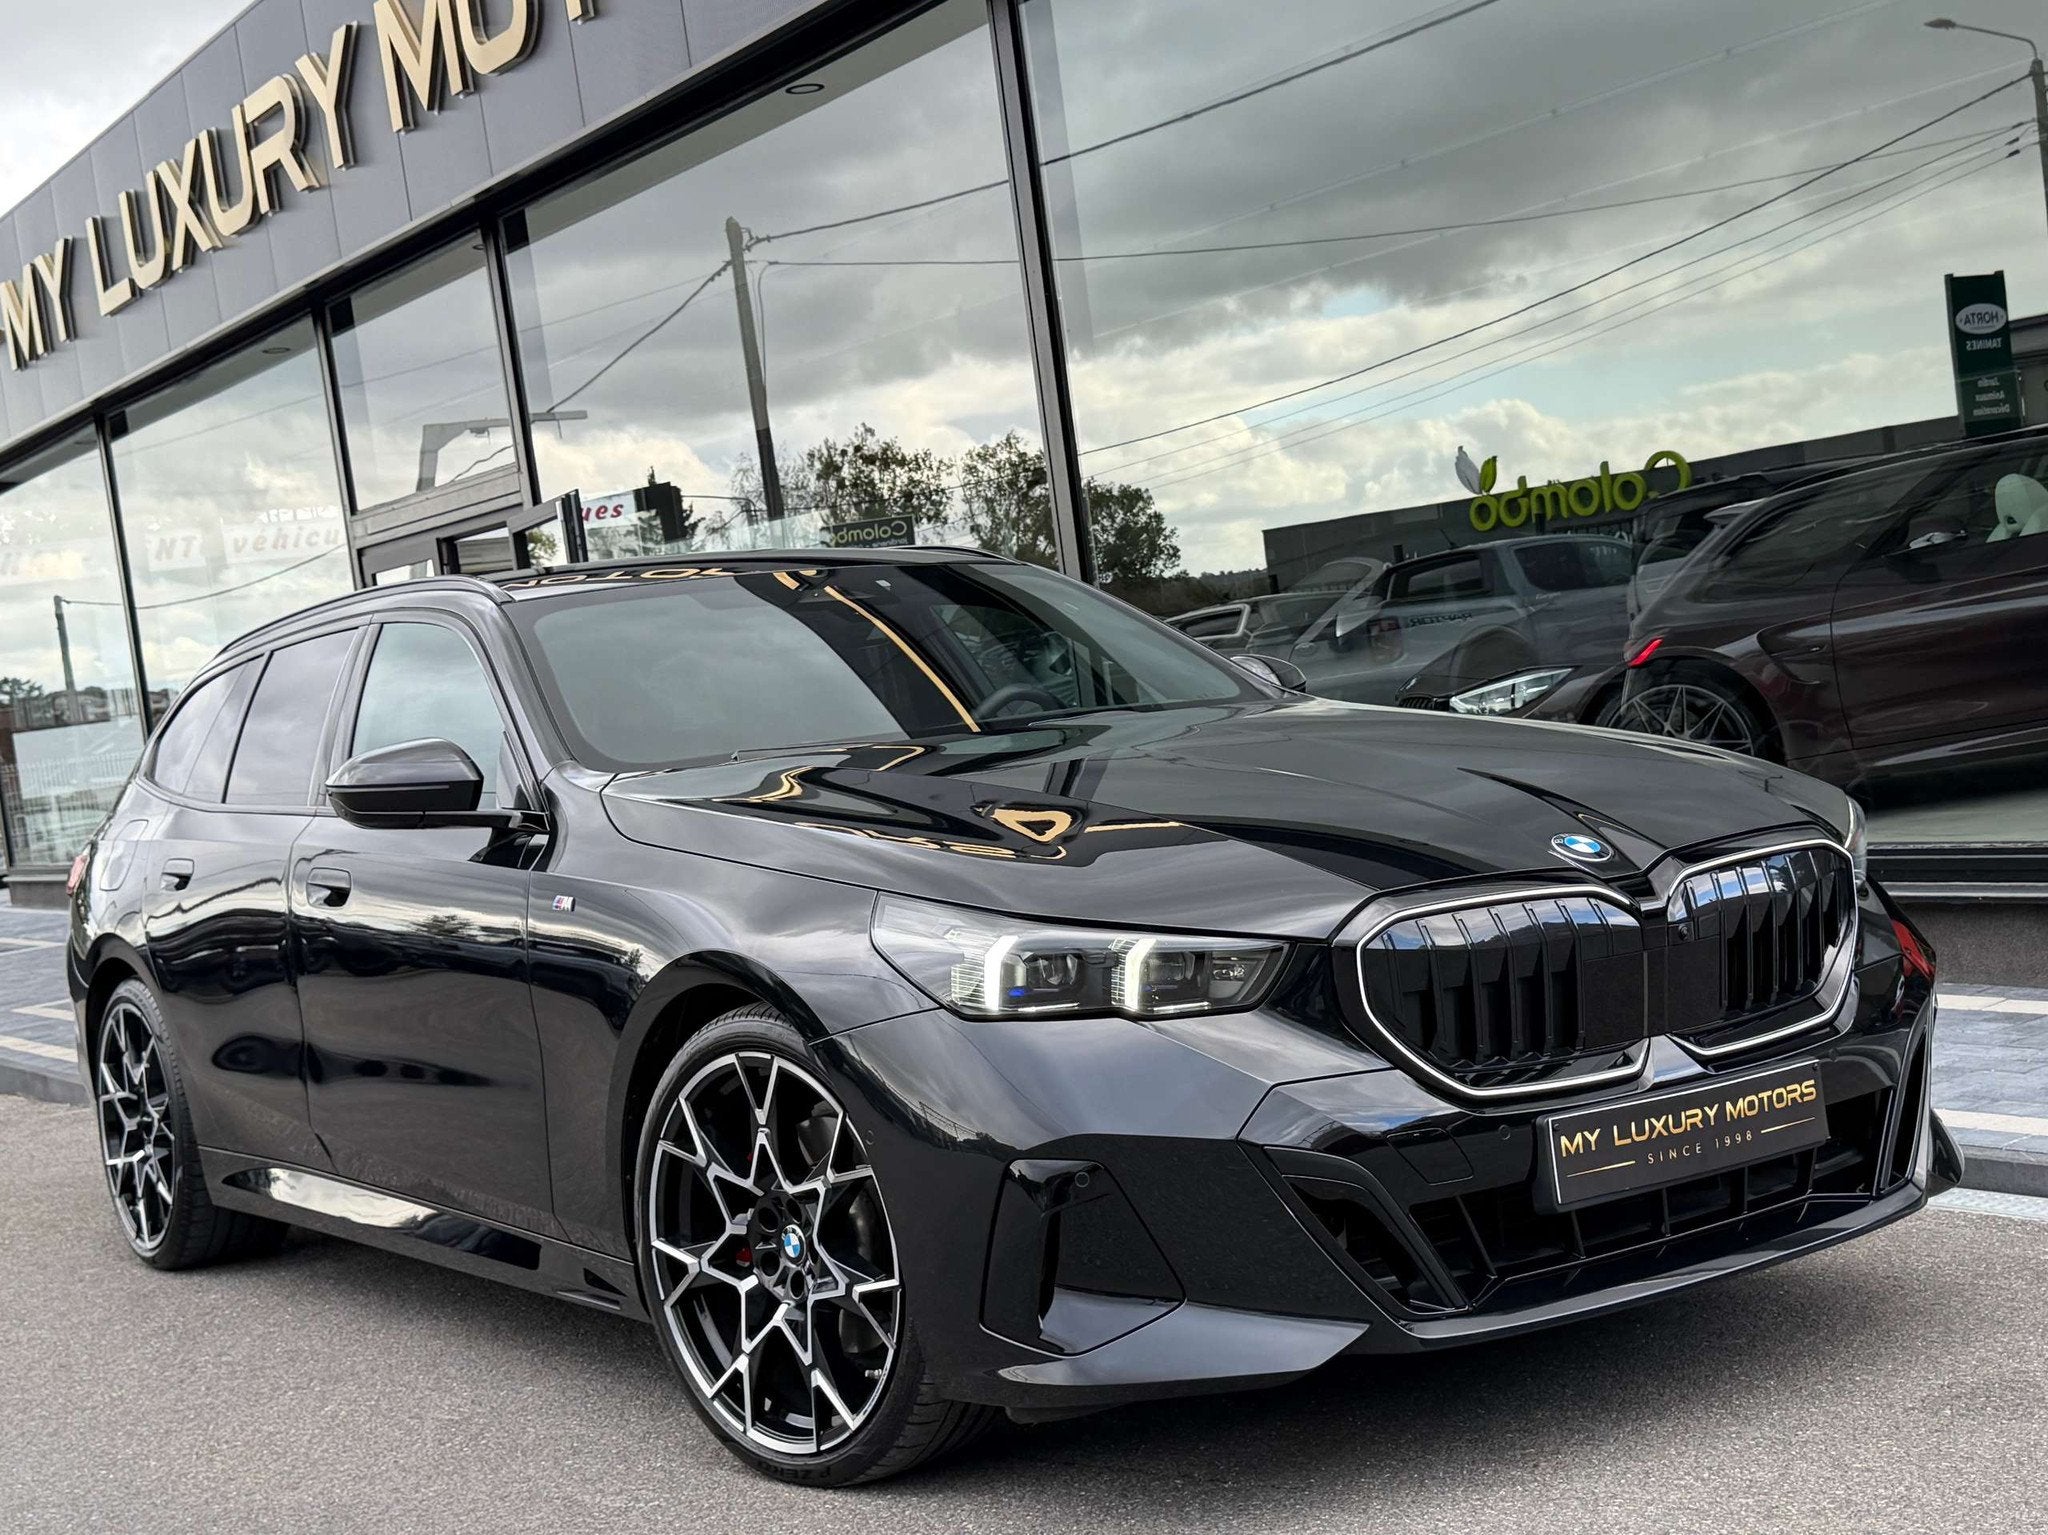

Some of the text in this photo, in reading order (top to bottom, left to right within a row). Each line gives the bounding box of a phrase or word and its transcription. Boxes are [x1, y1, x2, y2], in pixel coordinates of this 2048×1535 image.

[0, 0, 594, 371] MY LUXURY MO
[1559, 1079, 1818, 1158] MY LUXURY MOTORS
[1646, 1129, 1754, 1166] SINCE 1998
